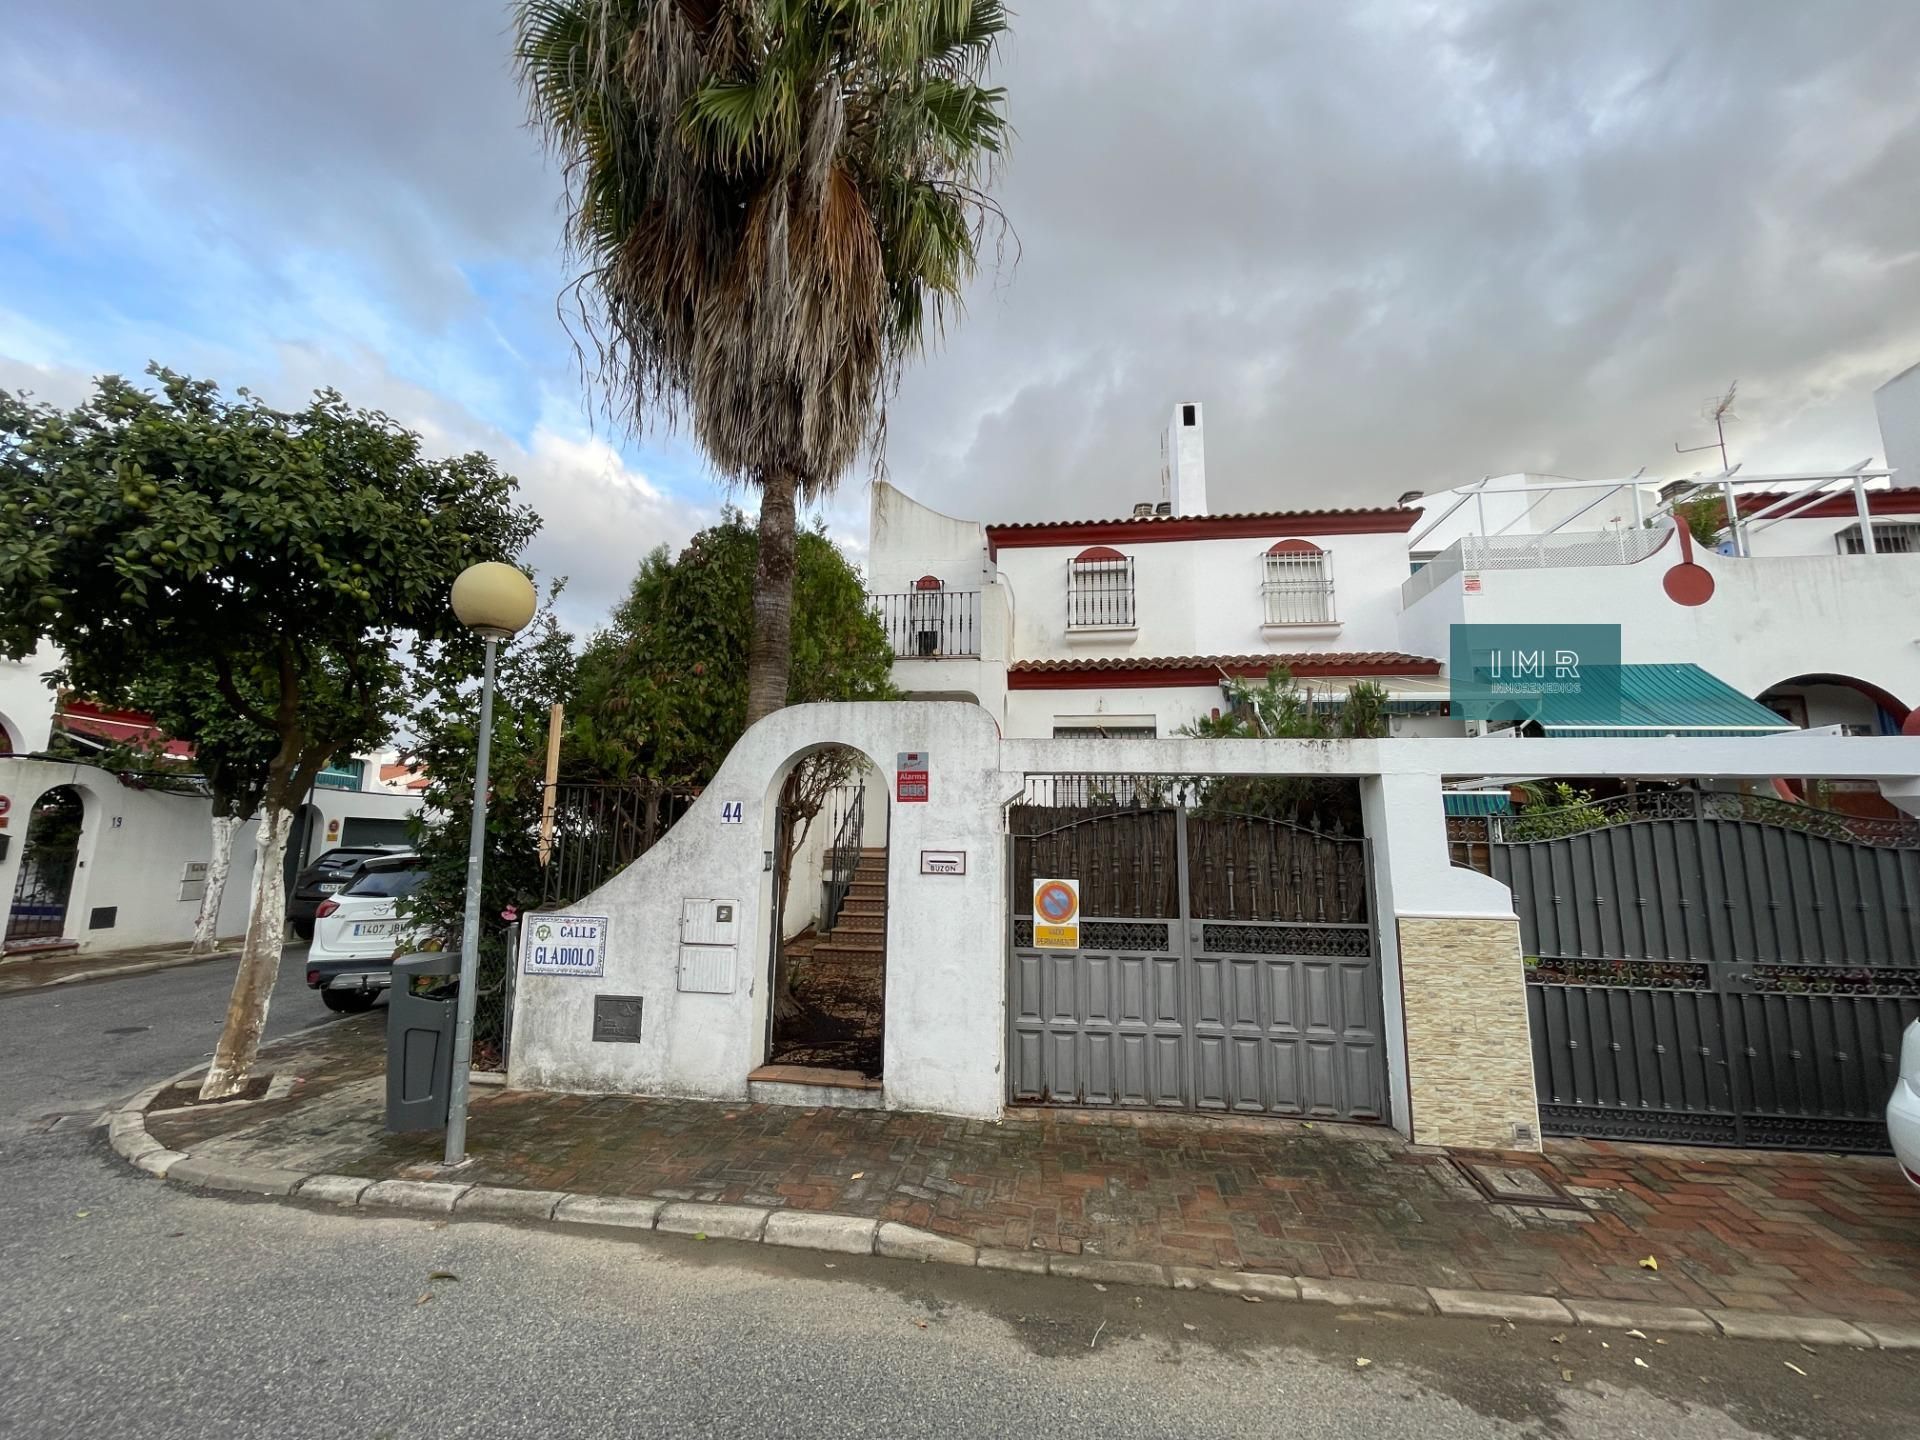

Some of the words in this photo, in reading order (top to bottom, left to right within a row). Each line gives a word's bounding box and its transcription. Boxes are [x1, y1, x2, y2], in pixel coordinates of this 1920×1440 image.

[900, 773, 927, 781] Alarma
[722, 802, 742, 823] 44
[112, 816, 123, 828] 19
[362, 924, 385, 934] 1407
[560, 926, 597, 939] CALLE
[535, 946, 595, 967] GLADIOLO
